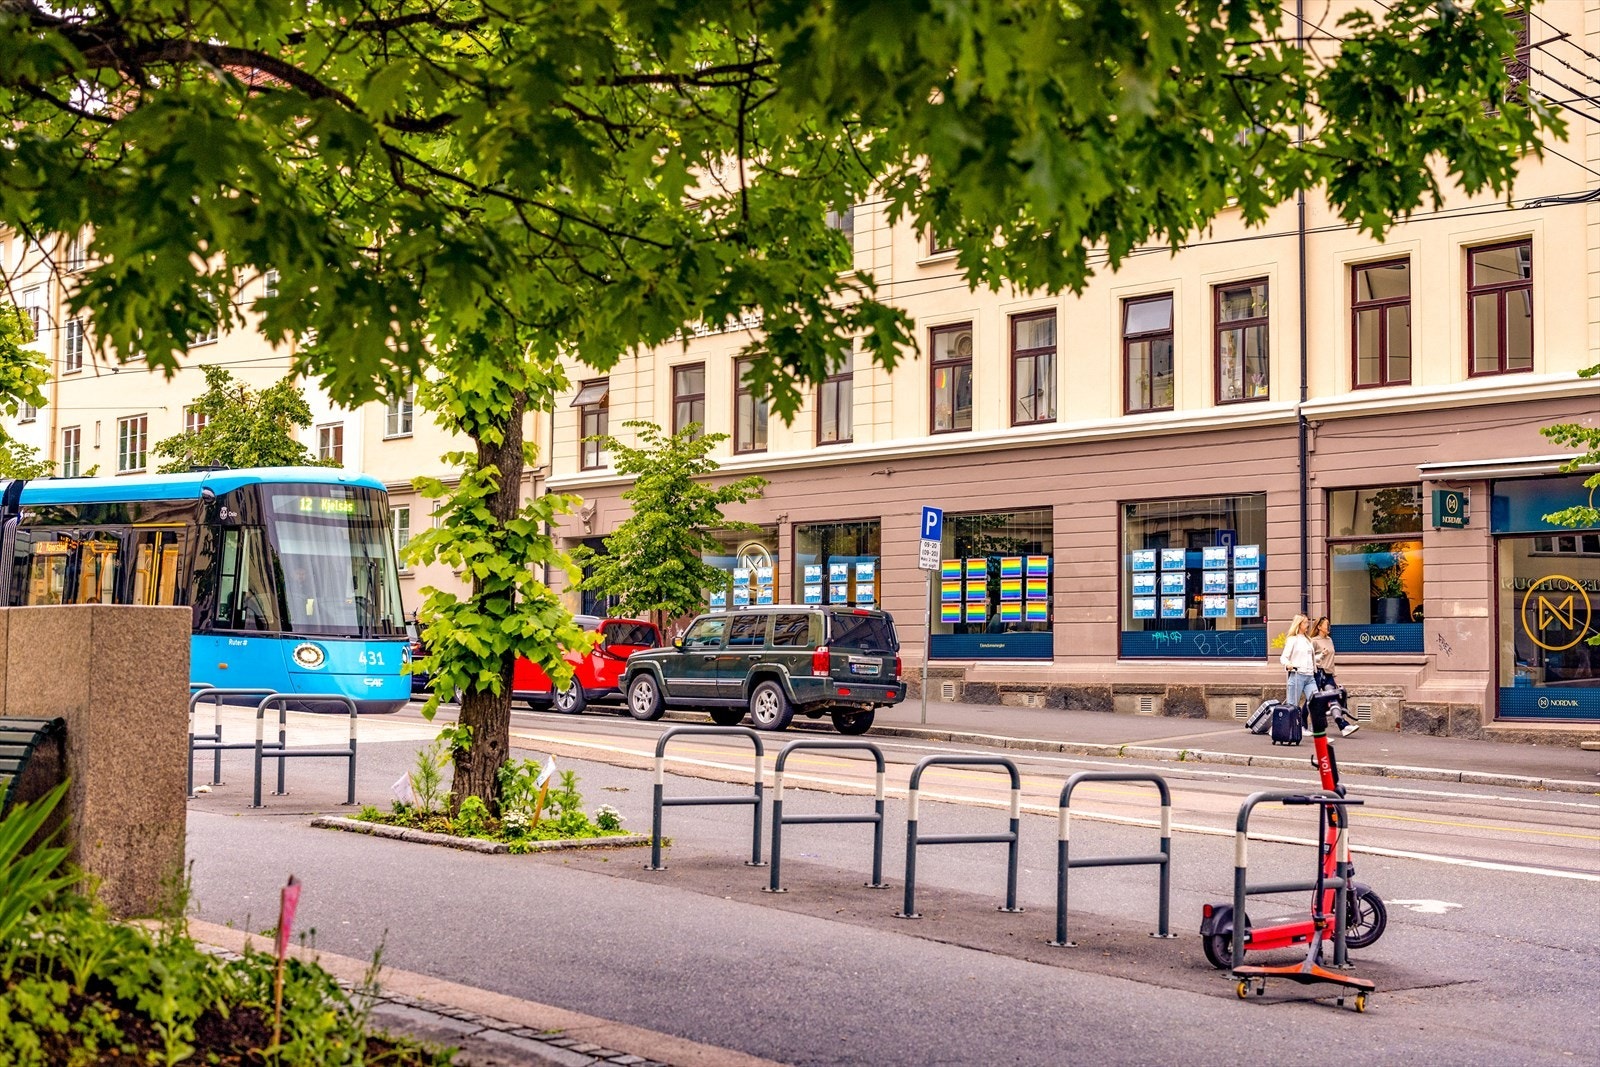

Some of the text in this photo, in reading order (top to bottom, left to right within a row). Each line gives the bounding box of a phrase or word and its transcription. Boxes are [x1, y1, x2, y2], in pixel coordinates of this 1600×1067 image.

[300, 497, 312, 511] 12
[926, 511, 937, 535] P
[1442, 516, 1462, 524] NORDVIK
[359, 651, 385, 666] 431
